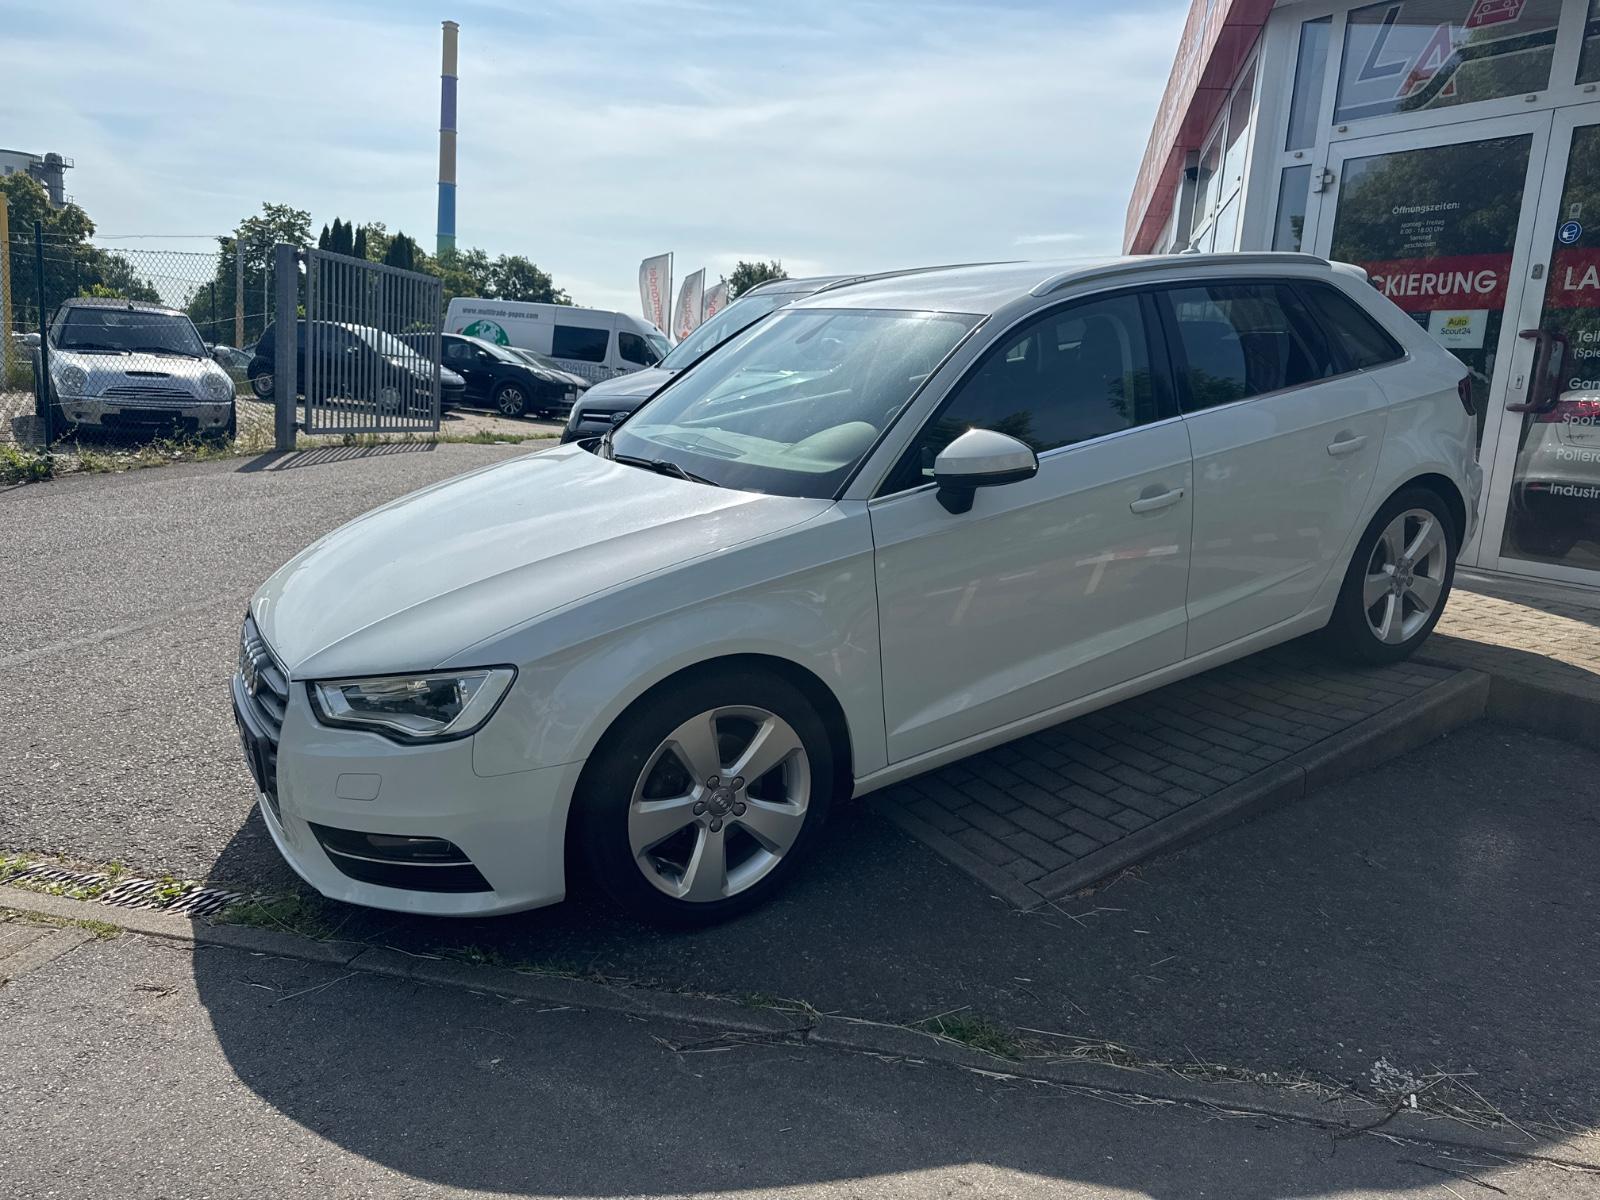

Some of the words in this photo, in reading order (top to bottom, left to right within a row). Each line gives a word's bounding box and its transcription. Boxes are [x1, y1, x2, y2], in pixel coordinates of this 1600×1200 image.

[1392, 202, 1460, 215] Öffnungszeiten:
[1448, 318, 1468, 327] Auto
[1440, 327, 1471, 336] Scout24
